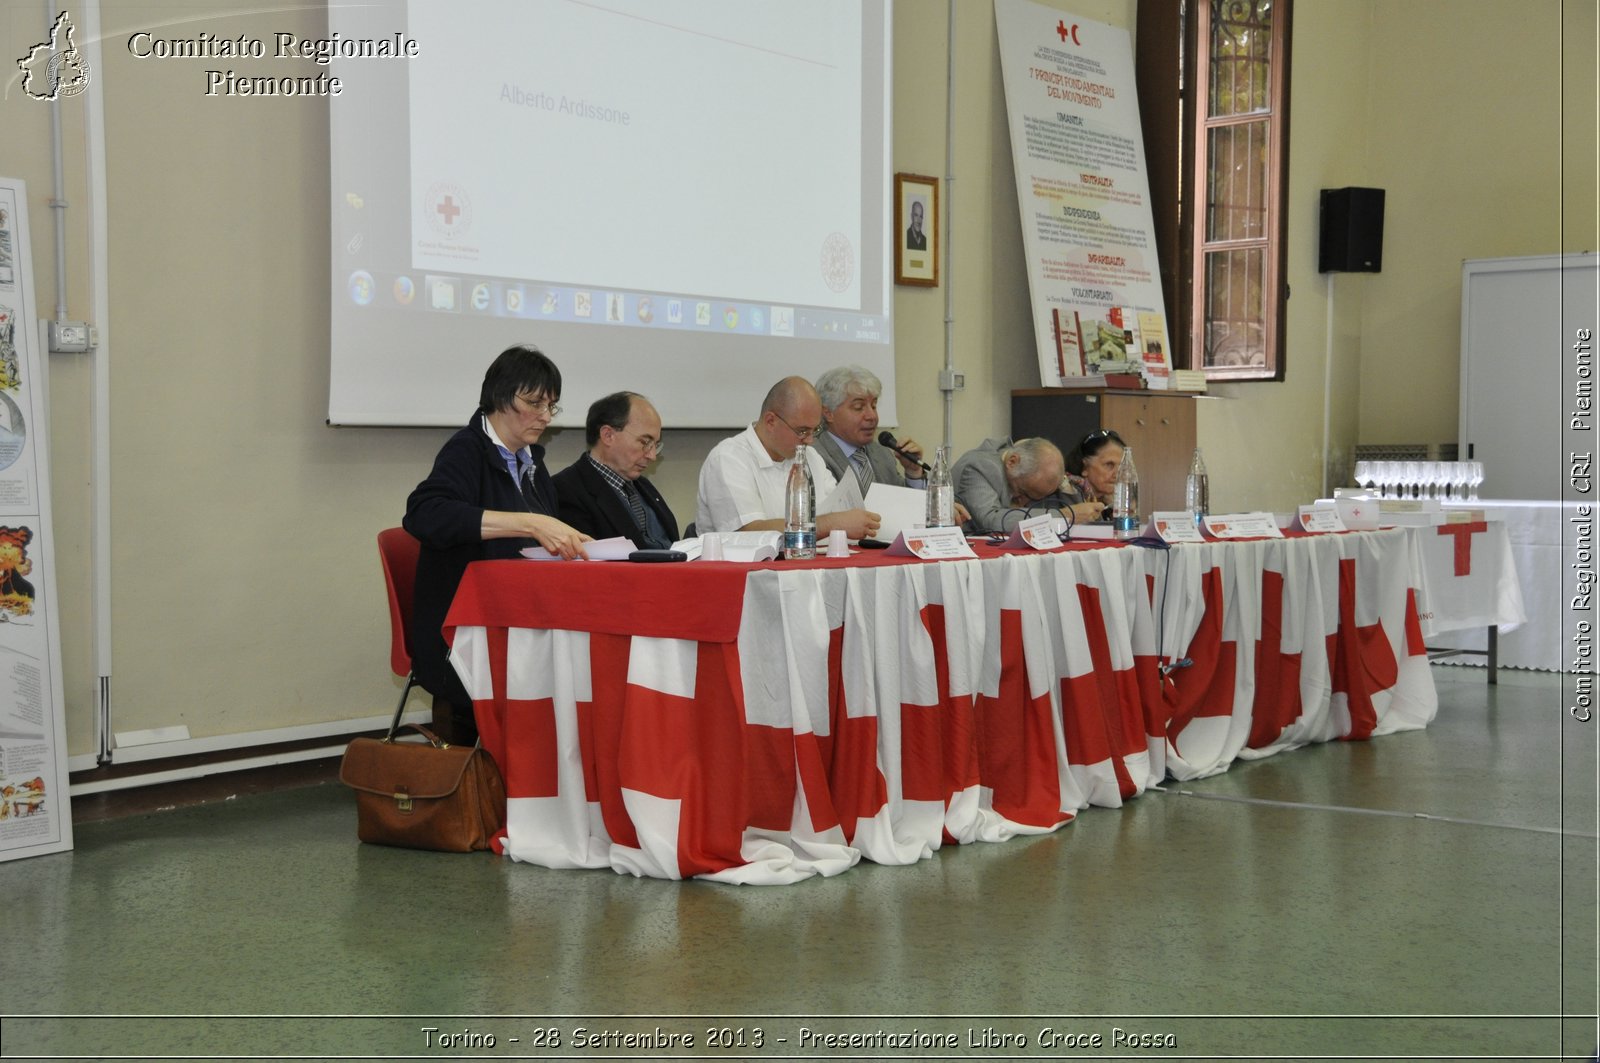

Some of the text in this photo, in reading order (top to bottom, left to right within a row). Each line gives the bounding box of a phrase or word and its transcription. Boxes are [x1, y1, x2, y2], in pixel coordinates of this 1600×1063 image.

[1035, 69, 1064, 87] PRINCIPI
[1064, 76, 1116, 98] FONDAMENTALI
[500, 83, 630, 126] Alberto Ardissone
[1047, 86, 1102, 109] DEL MOVIMENTO
[1071, 287, 1114, 300] VOLONTARIATO
